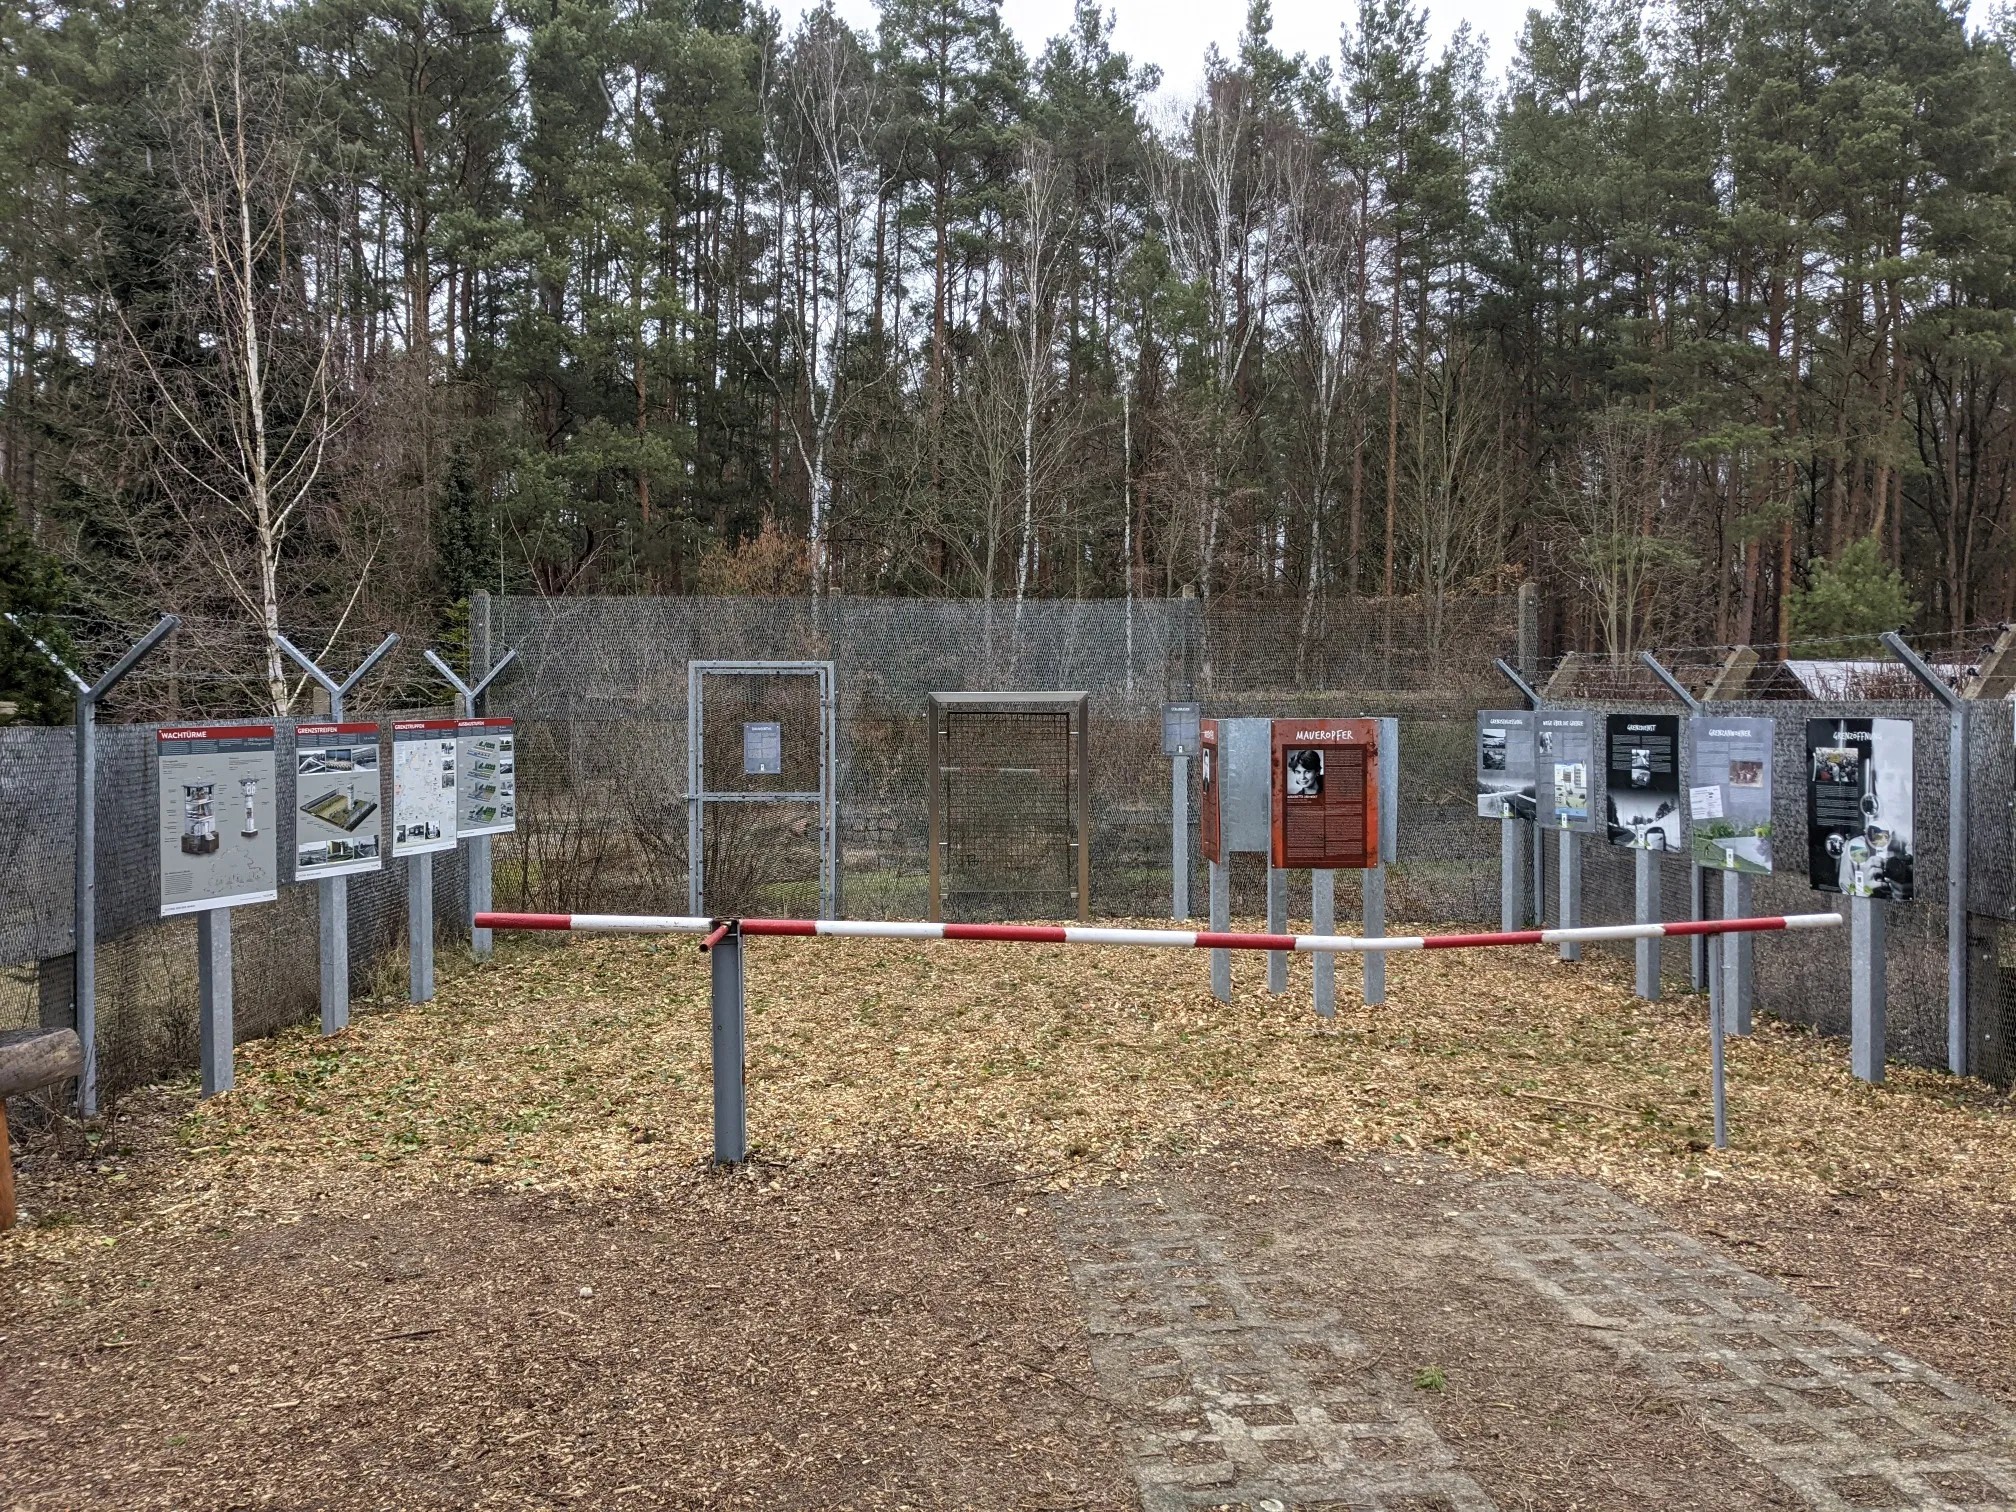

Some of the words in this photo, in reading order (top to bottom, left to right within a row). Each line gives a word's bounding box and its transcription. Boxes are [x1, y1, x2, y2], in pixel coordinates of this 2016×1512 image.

[161, 730, 207, 741] WACHTÜRME
[297, 726, 338, 735] GRENZSTREIFEN
[1295, 729, 1354, 741] MAUEROPFER
[1708, 729, 1752, 738] GRENZANWOHNER
[1832, 731, 1882, 742] GRENZÖFFNUNG
